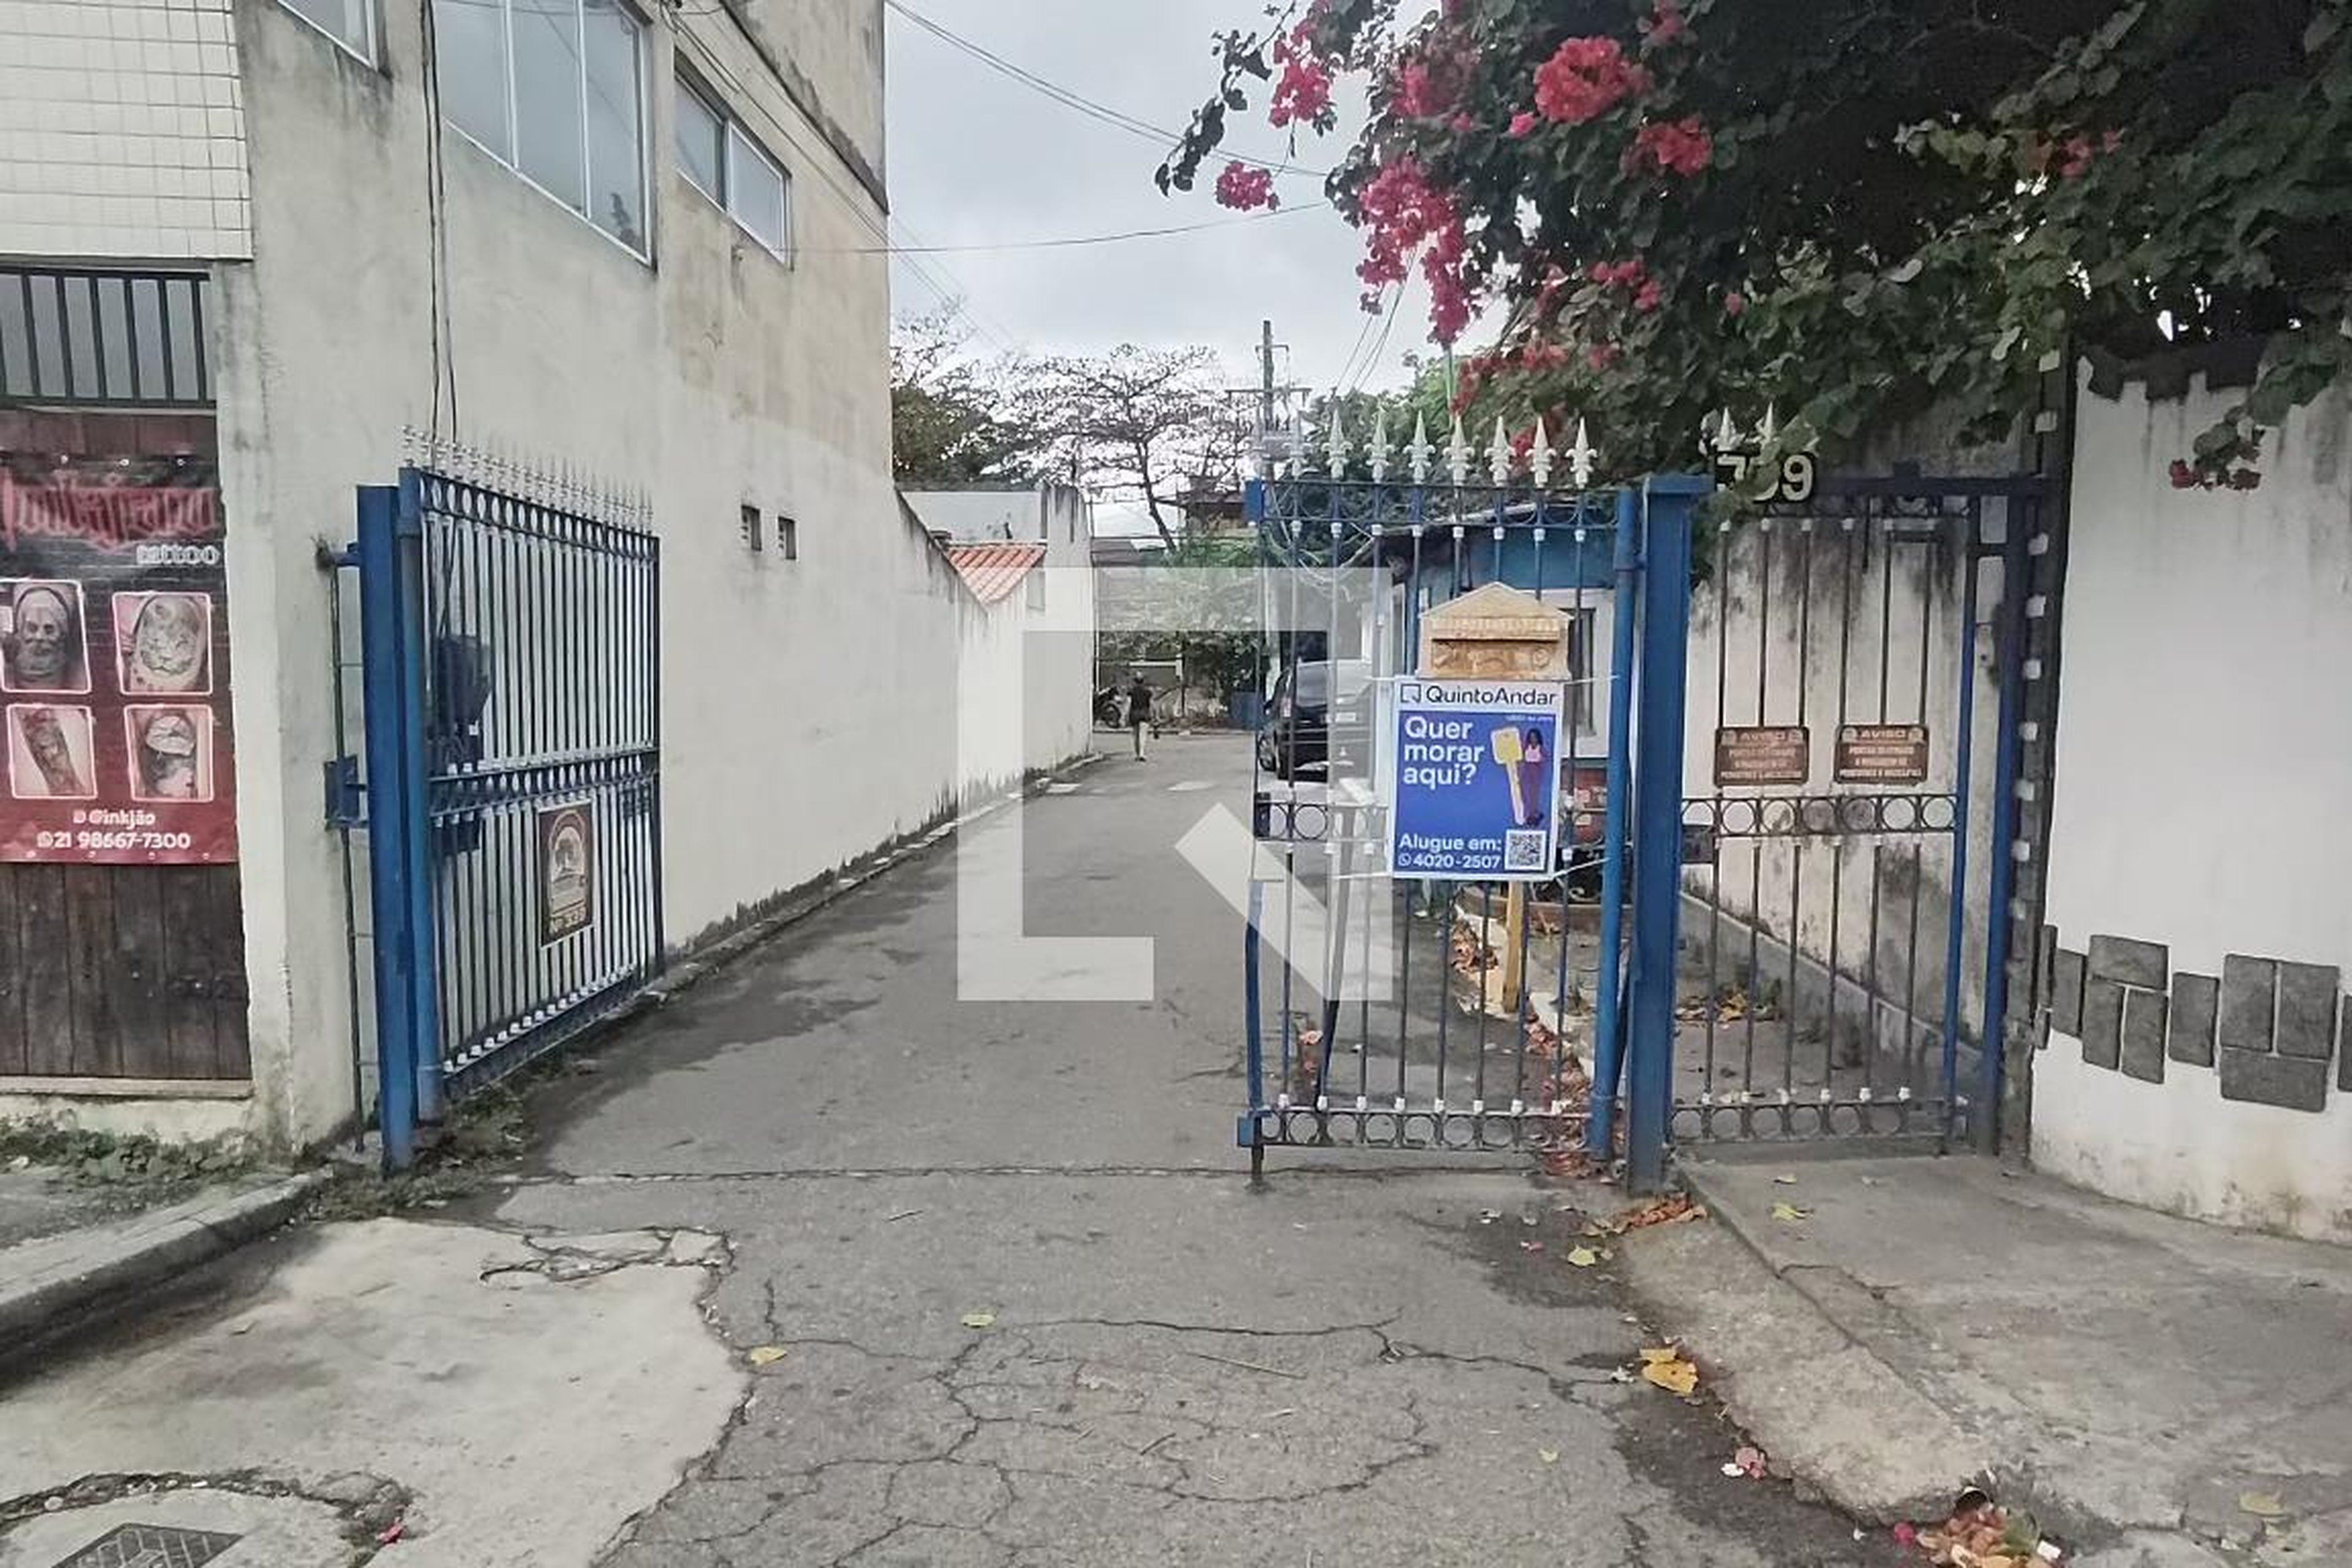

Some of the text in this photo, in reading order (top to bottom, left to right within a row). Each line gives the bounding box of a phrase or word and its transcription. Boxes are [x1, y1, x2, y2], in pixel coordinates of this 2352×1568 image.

[1426, 684, 1558, 706] QuintoAndar
[1404, 715, 1474, 739] Quer
[1404, 744, 1485, 763] morar
[1403, 763, 1477, 791] aqui?
[53, 831, 72, 848] 21
[1399, 832, 1502, 854] Alugue em:
[1413, 853, 1501, 869] 4020-2507
